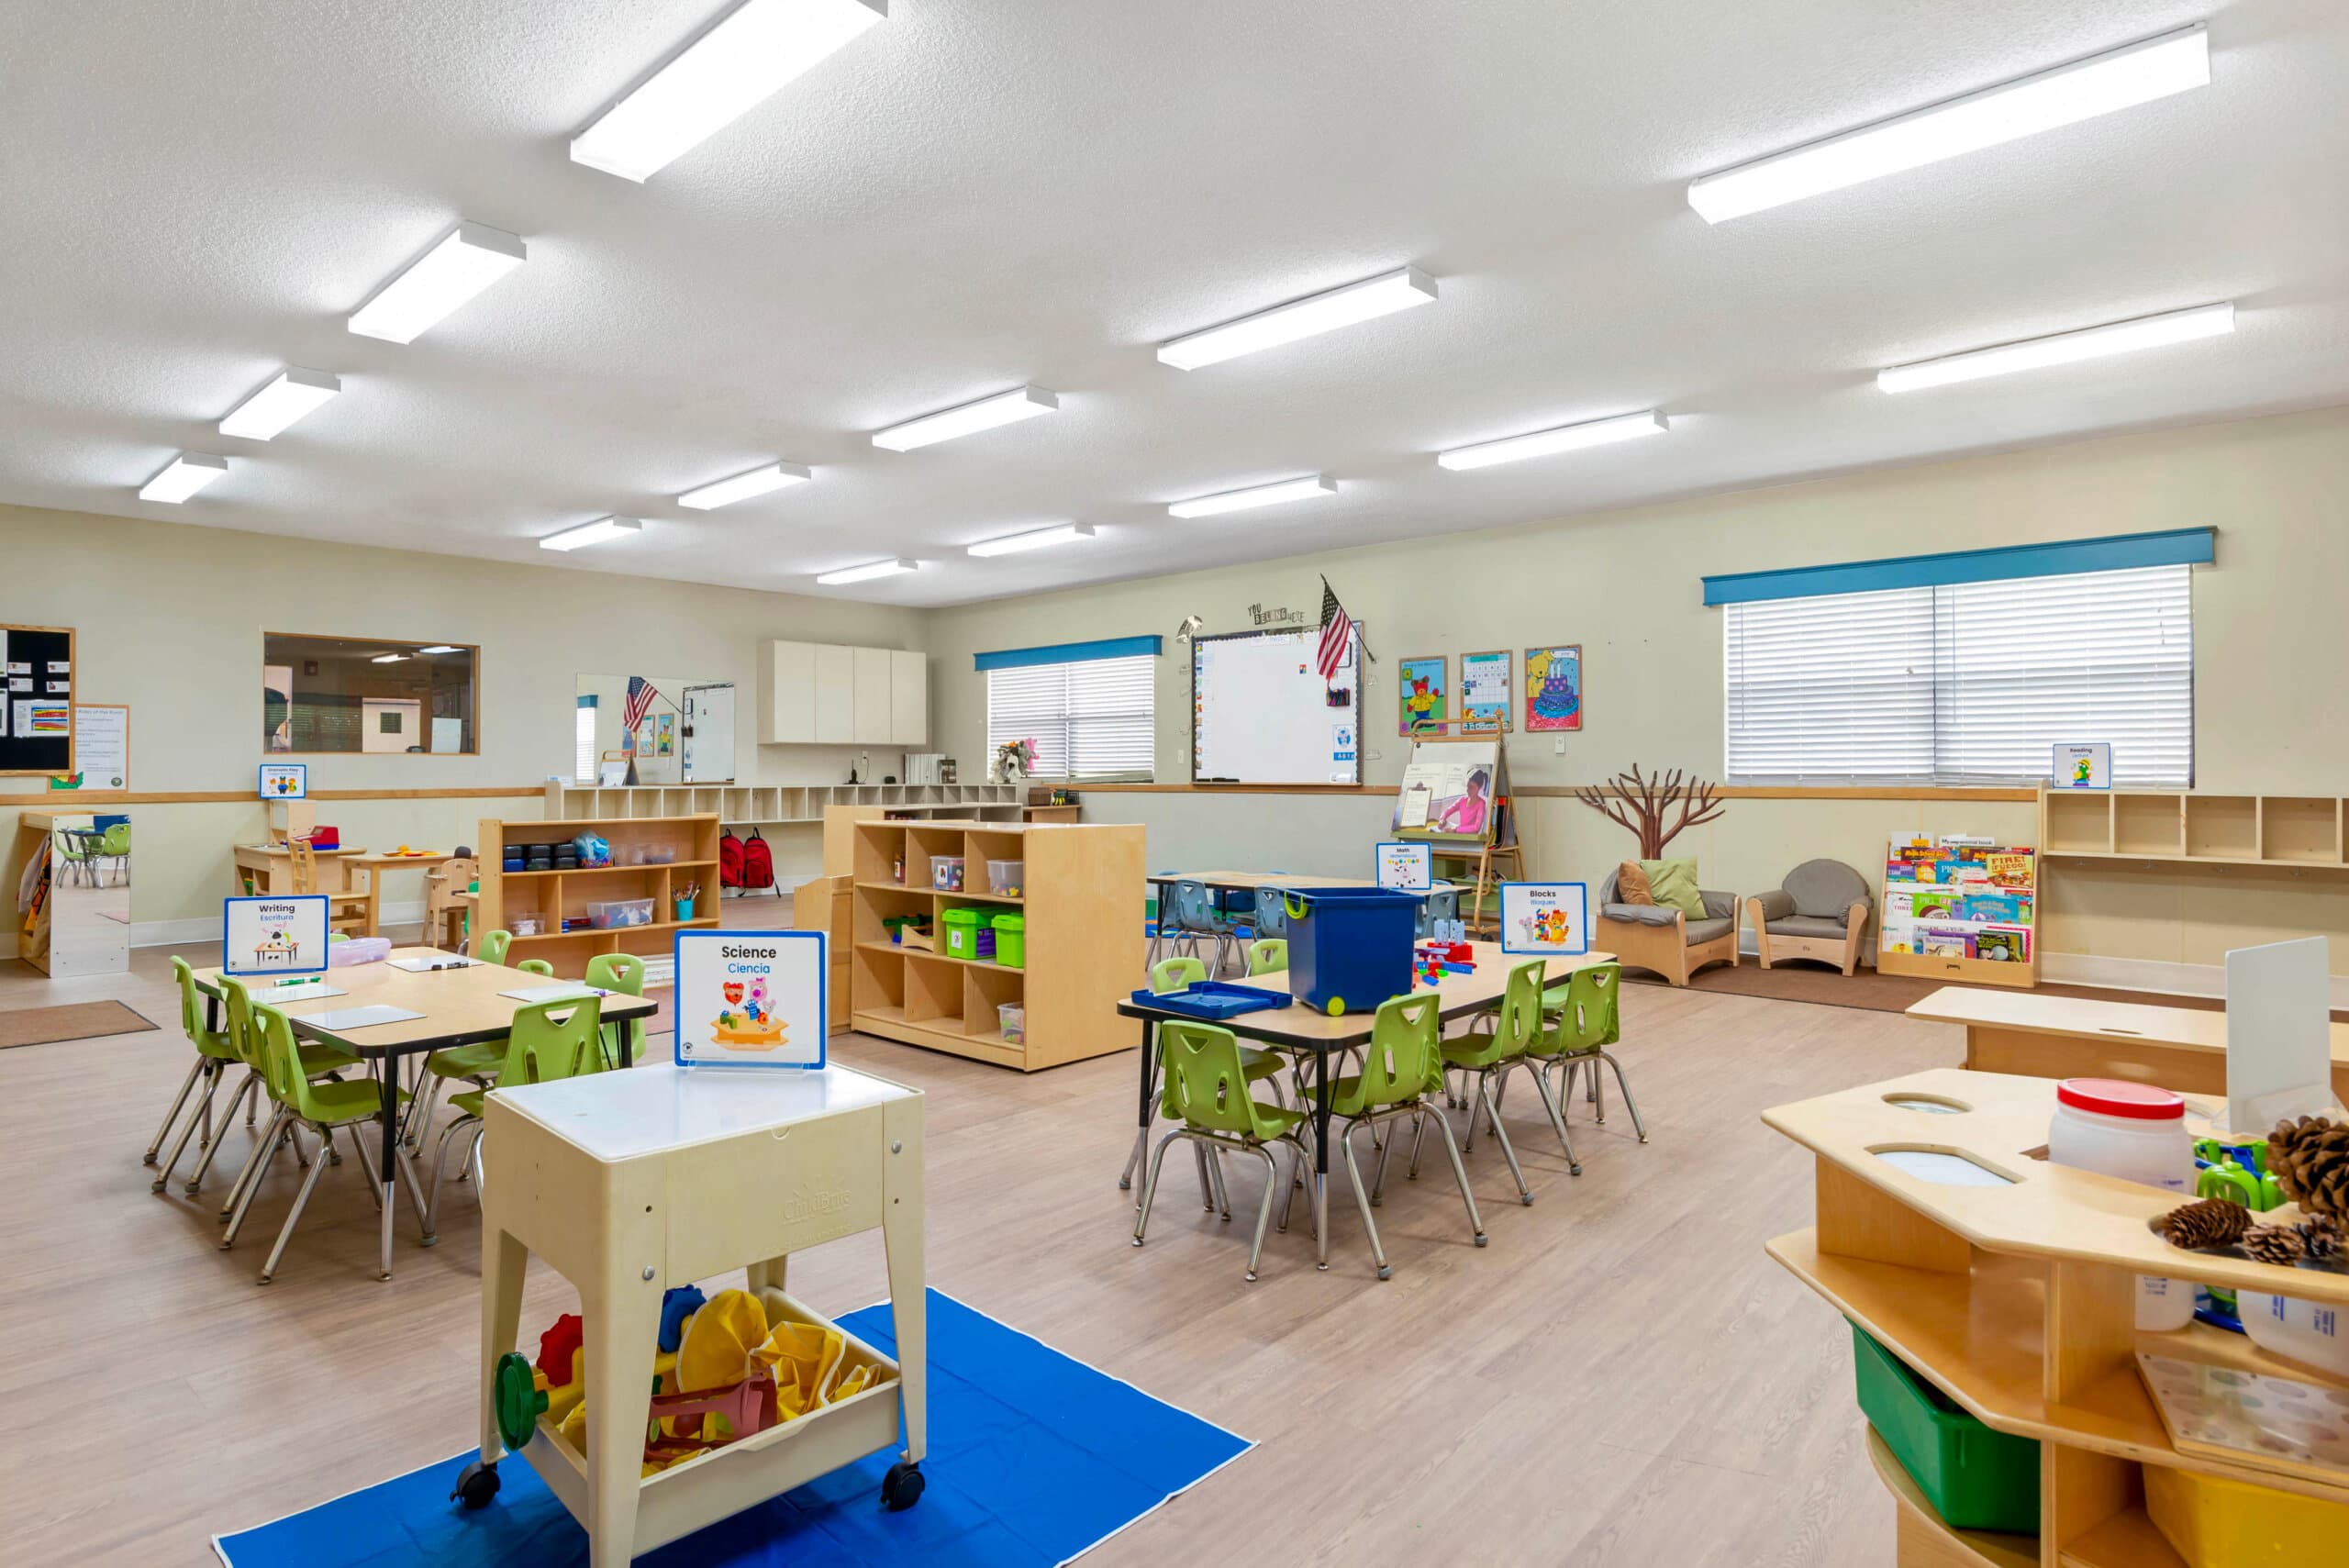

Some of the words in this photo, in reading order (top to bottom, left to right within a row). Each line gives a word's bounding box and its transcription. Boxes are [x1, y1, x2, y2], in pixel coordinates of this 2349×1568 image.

[1248, 603, 1261, 617] YOU
[1254, 607, 1286, 625] BELONG
[1991, 856, 2025, 864] FIRE!
[259, 904, 295, 914] Writing
[721, 944, 777, 959] Science
[728, 962, 771, 973] Ciencia
